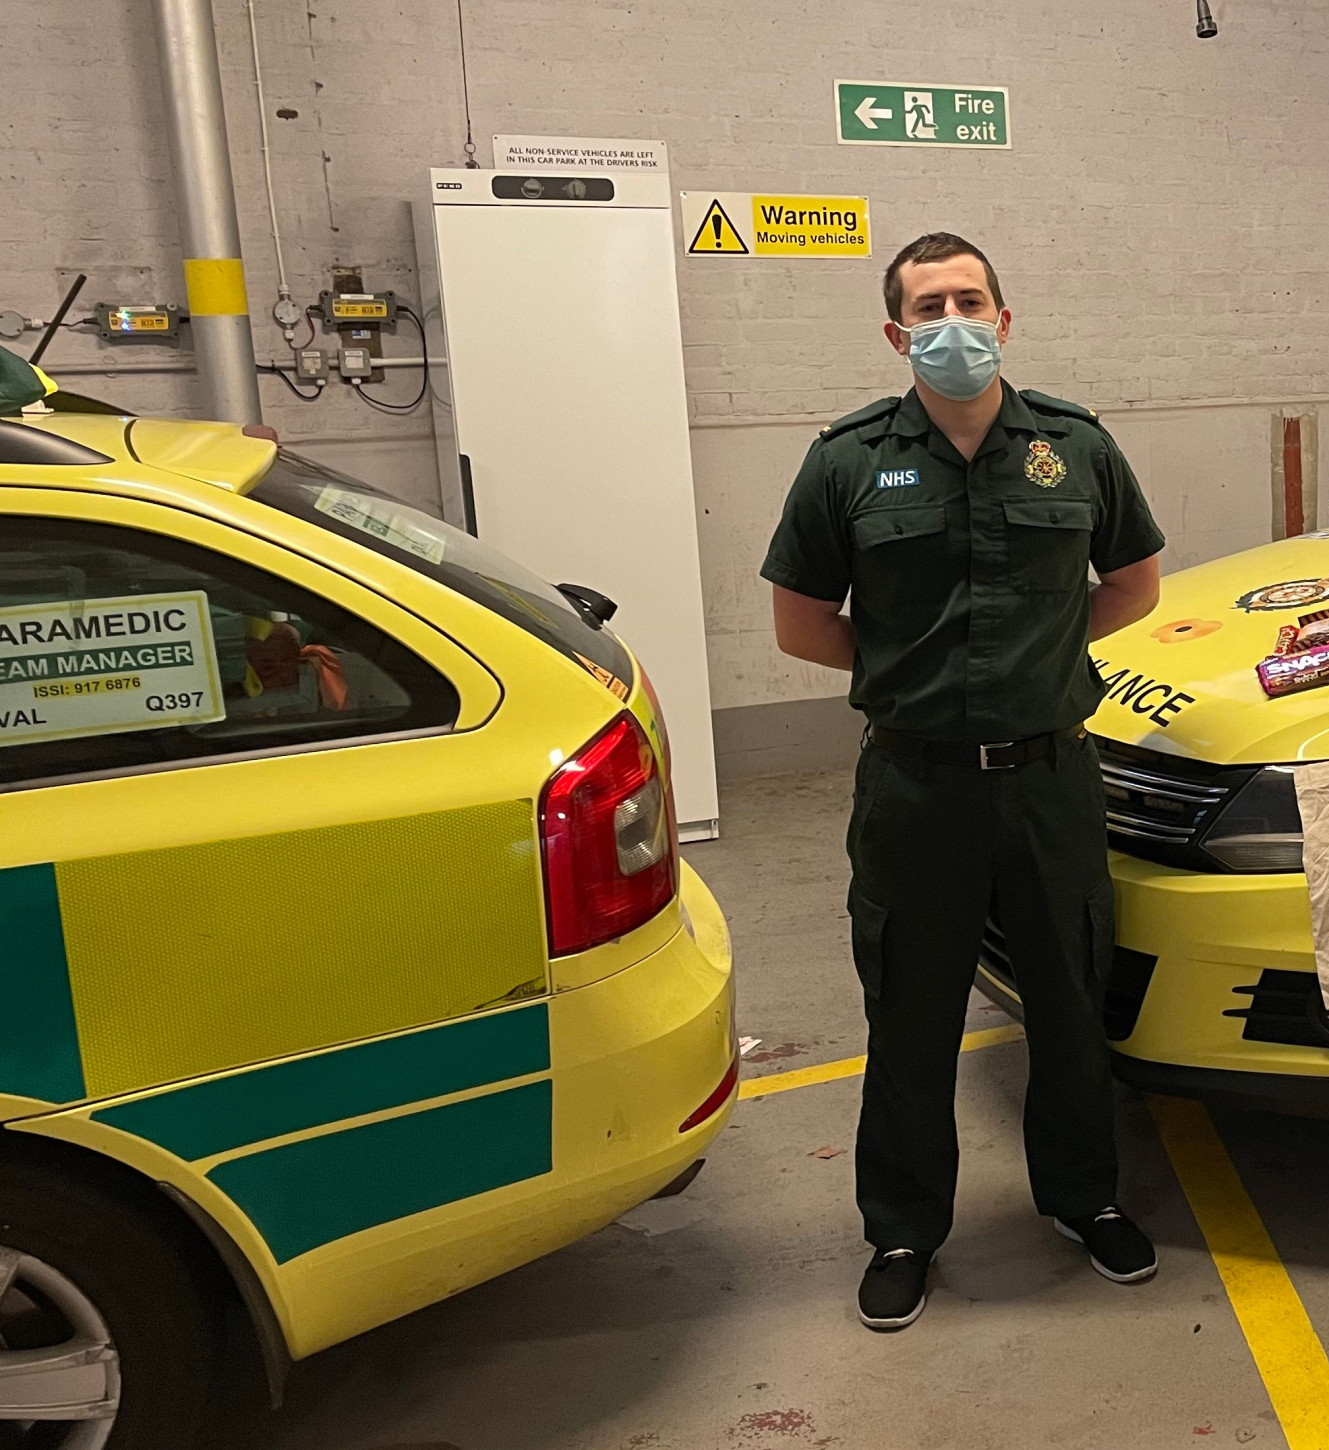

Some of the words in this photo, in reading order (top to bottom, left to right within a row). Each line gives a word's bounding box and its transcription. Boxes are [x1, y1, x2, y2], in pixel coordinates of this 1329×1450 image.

[954, 93, 995, 115] Fire
[956, 121, 996, 140] exit
[508, 147, 523, 155] ALL
[525, 148, 579, 156] NON-SERVICE
[581, 149, 618, 158] VEHICLES
[636, 151, 654, 159] LEFT
[517, 156, 535, 164] THIS
[606, 159, 639, 167] DRIVERS
[760, 205, 857, 232] Warning
[757, 231, 806, 246] Moving
[810, 233, 865, 245] vehicles
[879, 470, 916, 487] NHS
[56, 645, 194, 675] MANAGER
[33, 685, 70, 698] ISSI:
[74, 681, 100, 694] 917
[105, 677, 141, 690] 6876
[1094, 659, 1196, 728] ANCE
[145, 691, 204, 712] Q397
